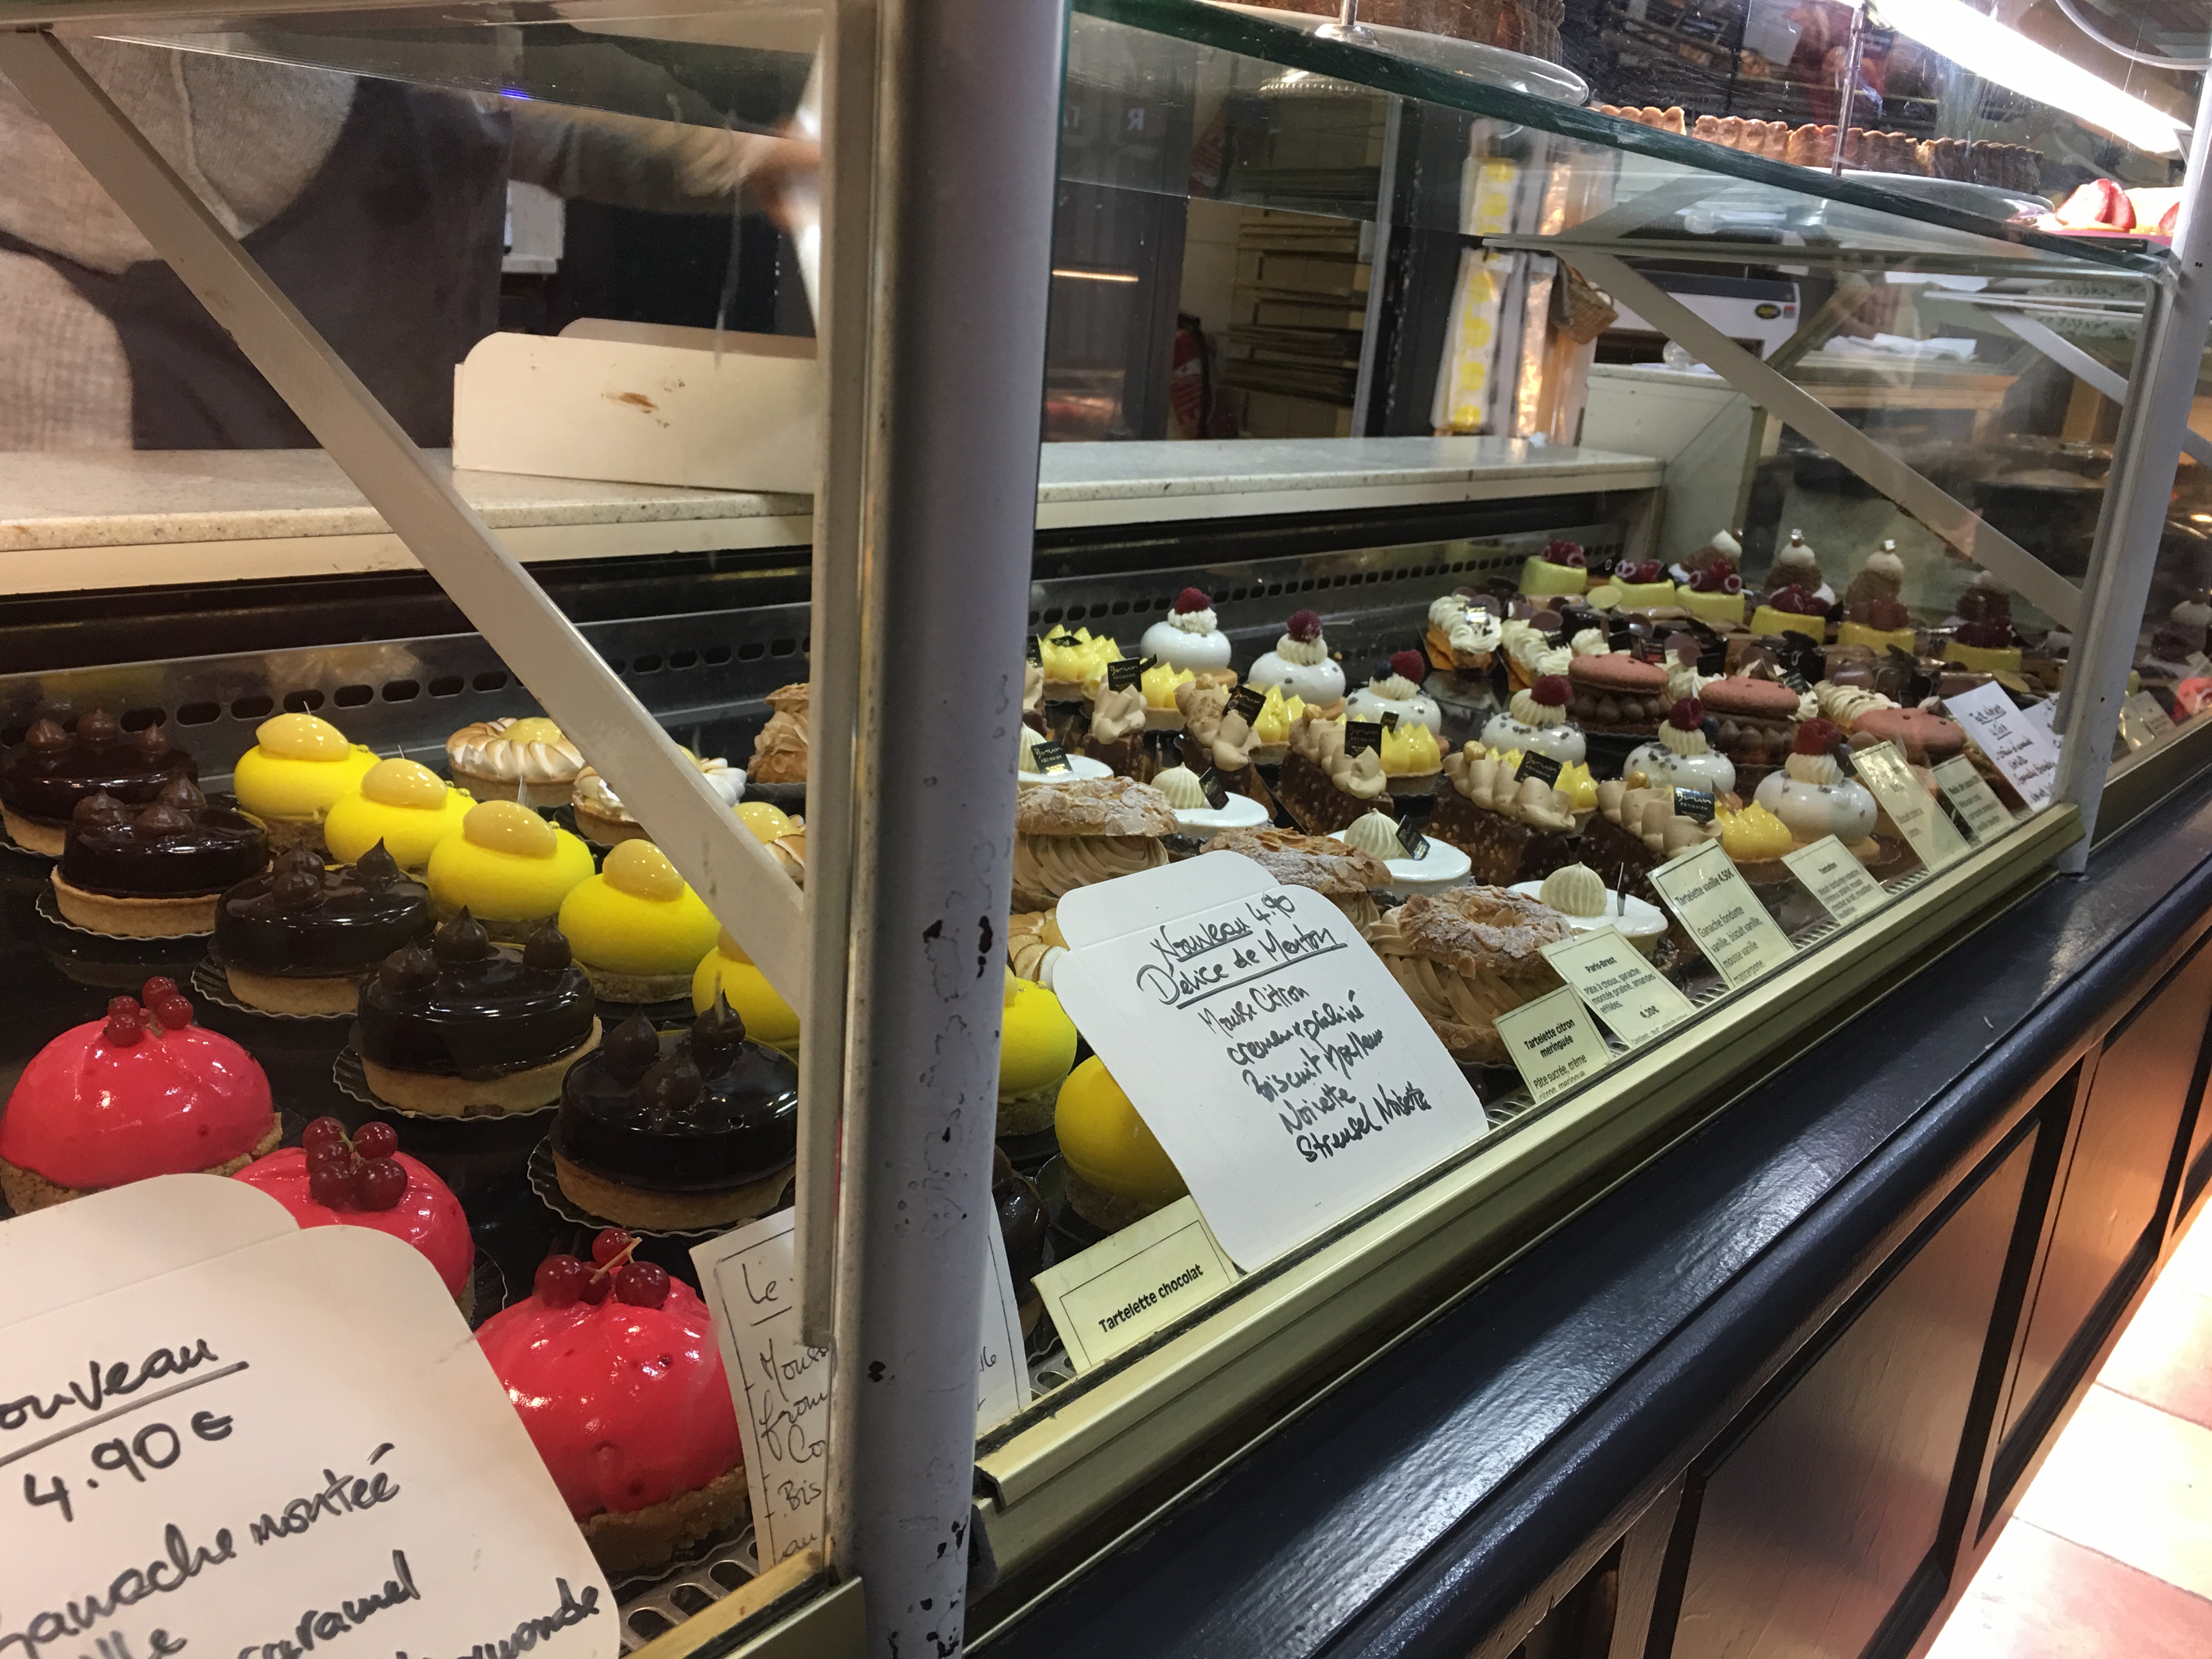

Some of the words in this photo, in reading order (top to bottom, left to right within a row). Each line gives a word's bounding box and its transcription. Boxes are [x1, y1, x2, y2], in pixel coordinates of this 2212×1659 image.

[1675, 886, 1705, 906] Tartelette
[1703, 877, 1721, 892] vanille
[1245, 894, 1295, 926] 4.90
[1697, 919, 1723, 938] Ganache
[1719, 906, 1745, 923] fondante
[1233, 948, 1260, 968] de
[1257, 923, 1338, 962] Menton
[1710, 936, 1732, 953] vanille,
[1726, 926, 1747, 942] biscuit
[1722, 951, 1743, 969] mousse
[1741, 940, 1759, 956] vanille
[1584, 956, 1617, 973] Paris-Brest
[1584, 984, 1599, 995] Pâte
[1601, 977, 1621, 988] choux,
[1618, 967, 1641, 982] ganache
[1592, 990, 1615, 1005] montée
[1612, 981, 1635, 996] praliné,
[1632, 973, 1656, 988] amandes
[1198, 1001, 1257, 1038] Mousse
[1249, 984, 1310, 1013] Citron
[1639, 1005, 1660, 1019] 4,20€
[1523, 1028, 1557, 1050] Tartelette
[1556, 1019, 1575, 1034] citron
[1540, 1035, 1573, 1058] meringuée
[1242, 1047, 1323, 1103] Biscuit
[1533, 1075, 1549, 1090] Pâte
[1547, 1065, 1570, 1083] sucrée,
[1568, 1054, 1587, 1070] crème
[1278, 1082, 1357, 1135] Noisette
[1098, 1291, 1158, 1333] Tartelette
[1158, 1263, 1204, 1299] chocolat
[0, 1339, 218, 1430] ouveau
[0, 1522, 236, 1659] anache
